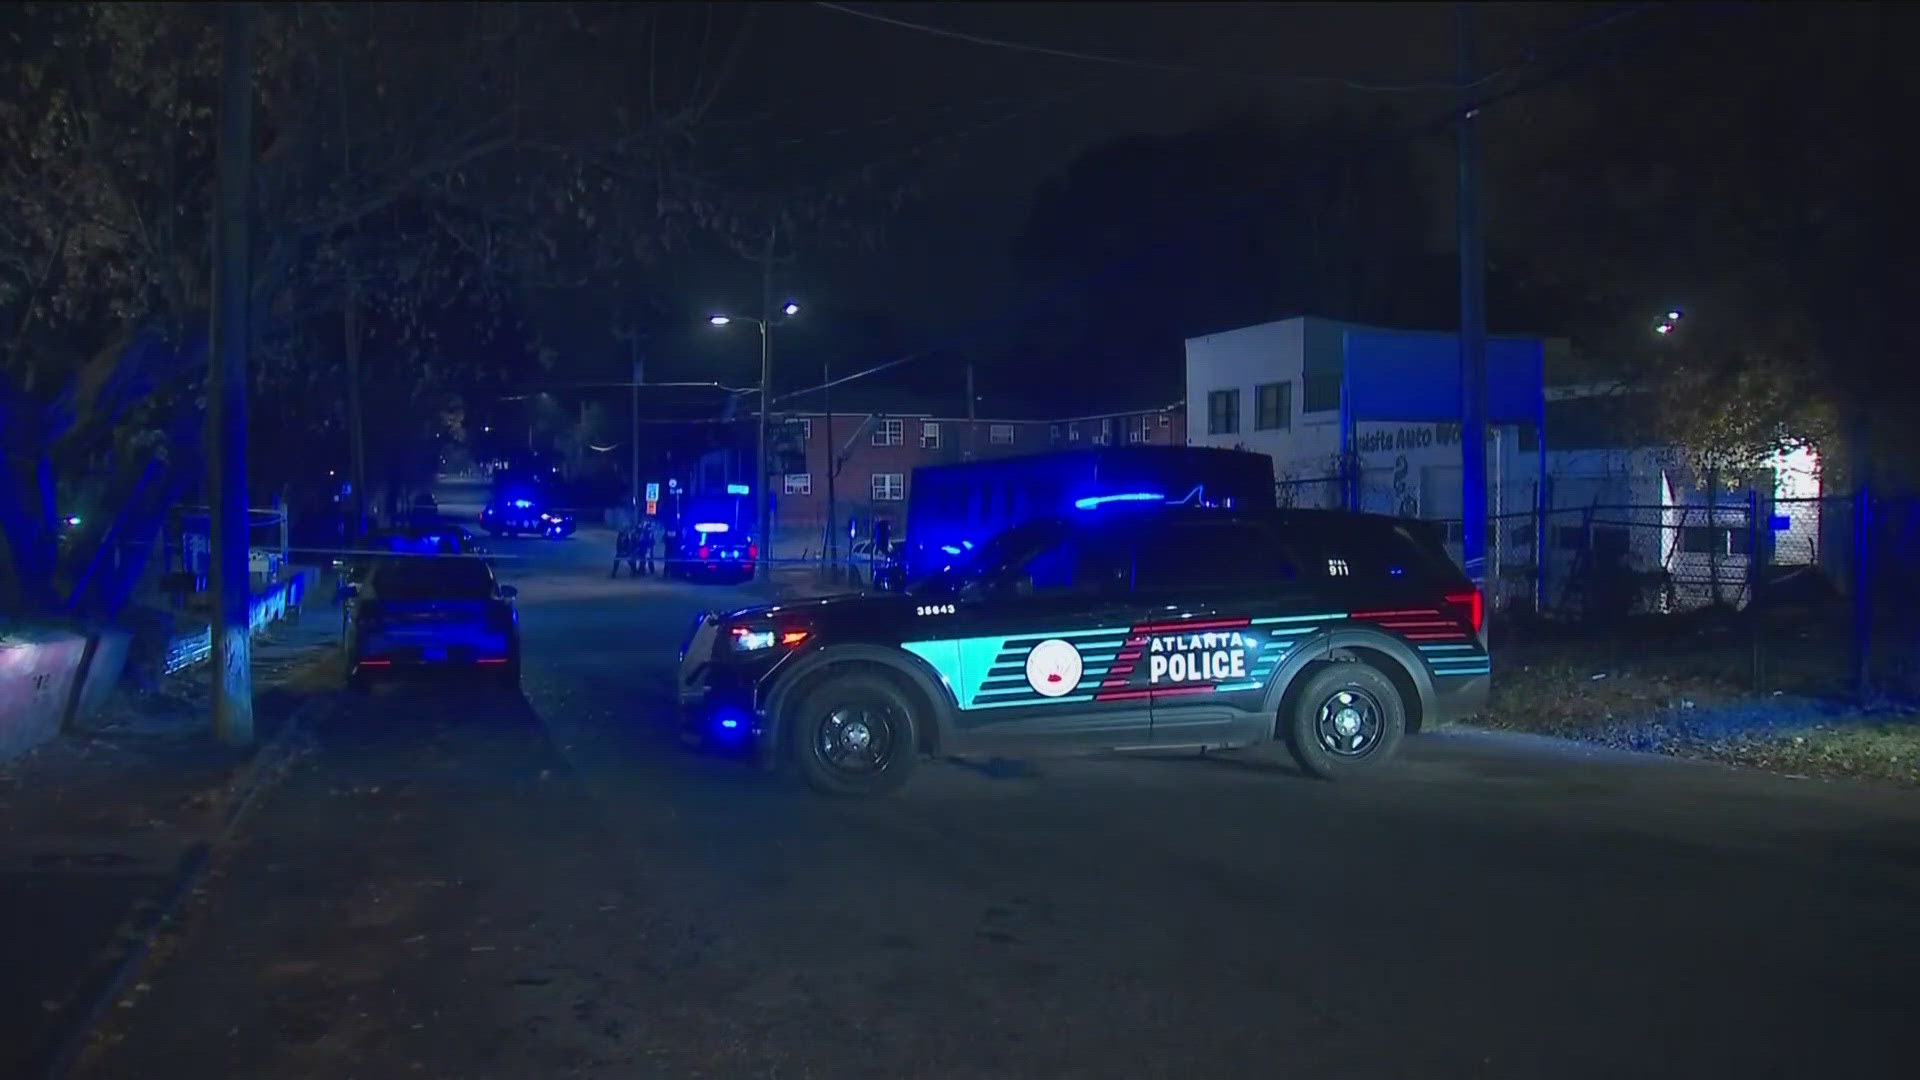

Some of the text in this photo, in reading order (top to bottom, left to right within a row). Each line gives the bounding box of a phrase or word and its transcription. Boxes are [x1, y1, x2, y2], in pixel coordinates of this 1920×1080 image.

[1359, 429, 1394, 452] uisite
[1396, 426, 1433, 449] Auto
[1329, 565, 1349, 577] 911
[1150, 631, 1244, 653] ATLANTA
[1150, 649, 1246, 684] POLICE
